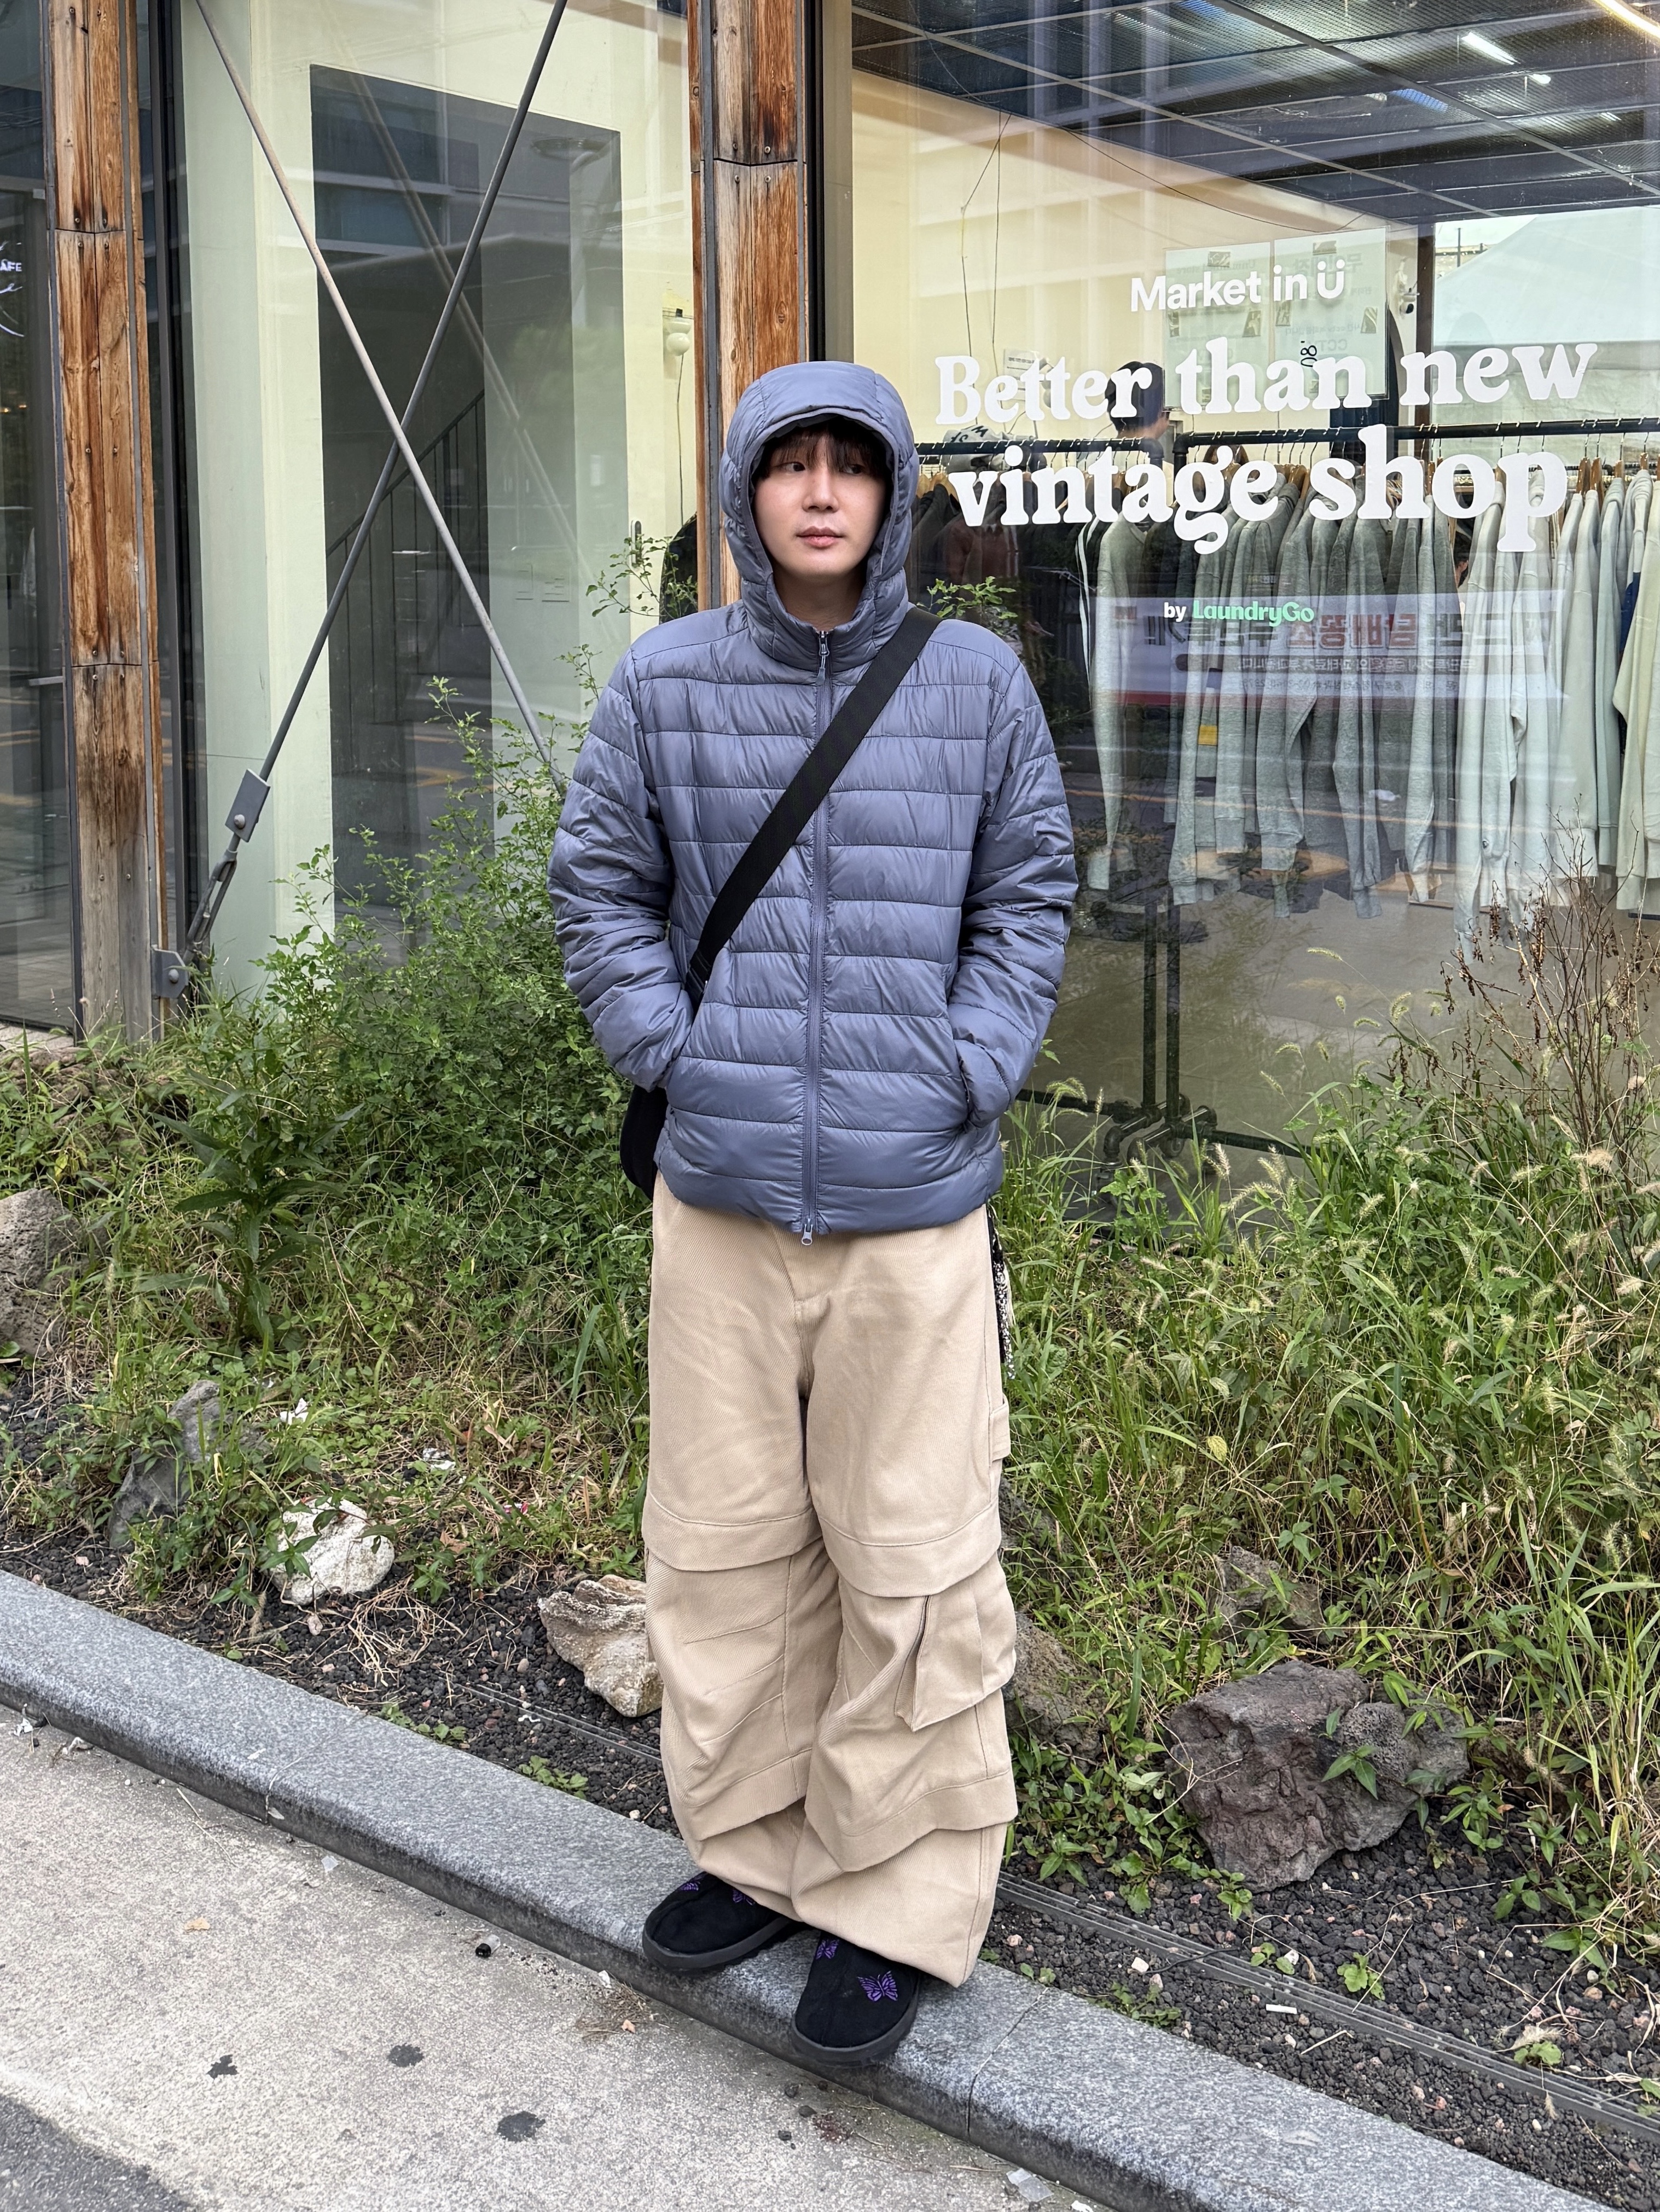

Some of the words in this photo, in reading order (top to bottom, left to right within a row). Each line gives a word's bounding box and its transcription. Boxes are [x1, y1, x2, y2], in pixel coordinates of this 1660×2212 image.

[1131, 271, 1262, 312] Market
[1273, 265, 1308, 301] in
[1316, 259, 1346, 299] Ü
[935, 355, 1152, 426] Better
[1175, 336, 1372, 415] than
[1400, 343, 1598, 405] new
[948, 445, 1279, 554] vintage
[1309, 424, 1568, 552] shop
[1163, 602, 1187, 623] by
[1193, 601, 1315, 628] LaundryGo
